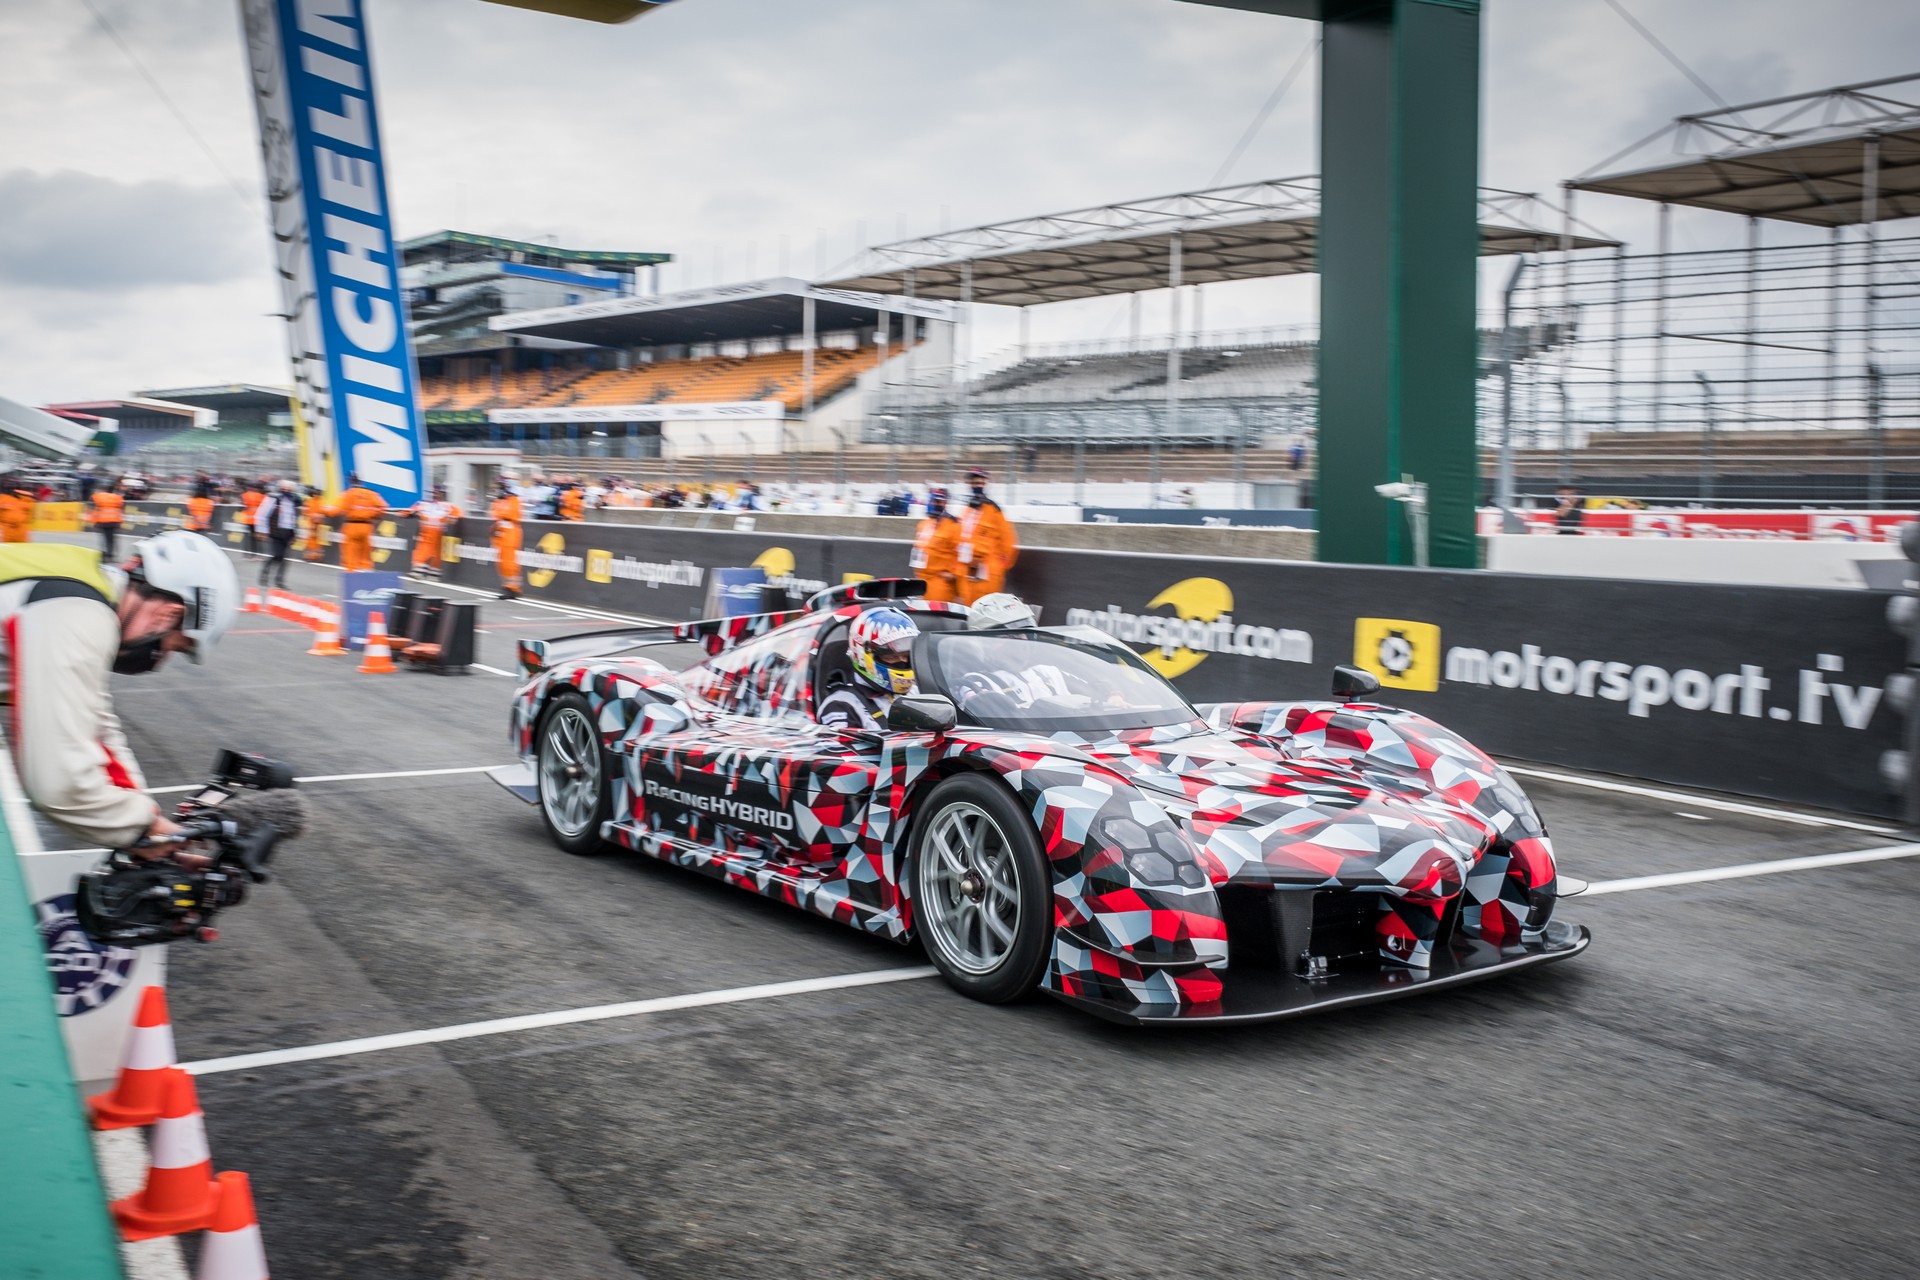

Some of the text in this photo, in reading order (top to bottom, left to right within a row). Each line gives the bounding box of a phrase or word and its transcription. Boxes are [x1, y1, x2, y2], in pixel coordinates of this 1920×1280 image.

[295, 0, 416, 494] MICHELIN
[1066, 604, 1313, 664] motorsport.com
[1445, 643, 1883, 730] motorsport.tv
